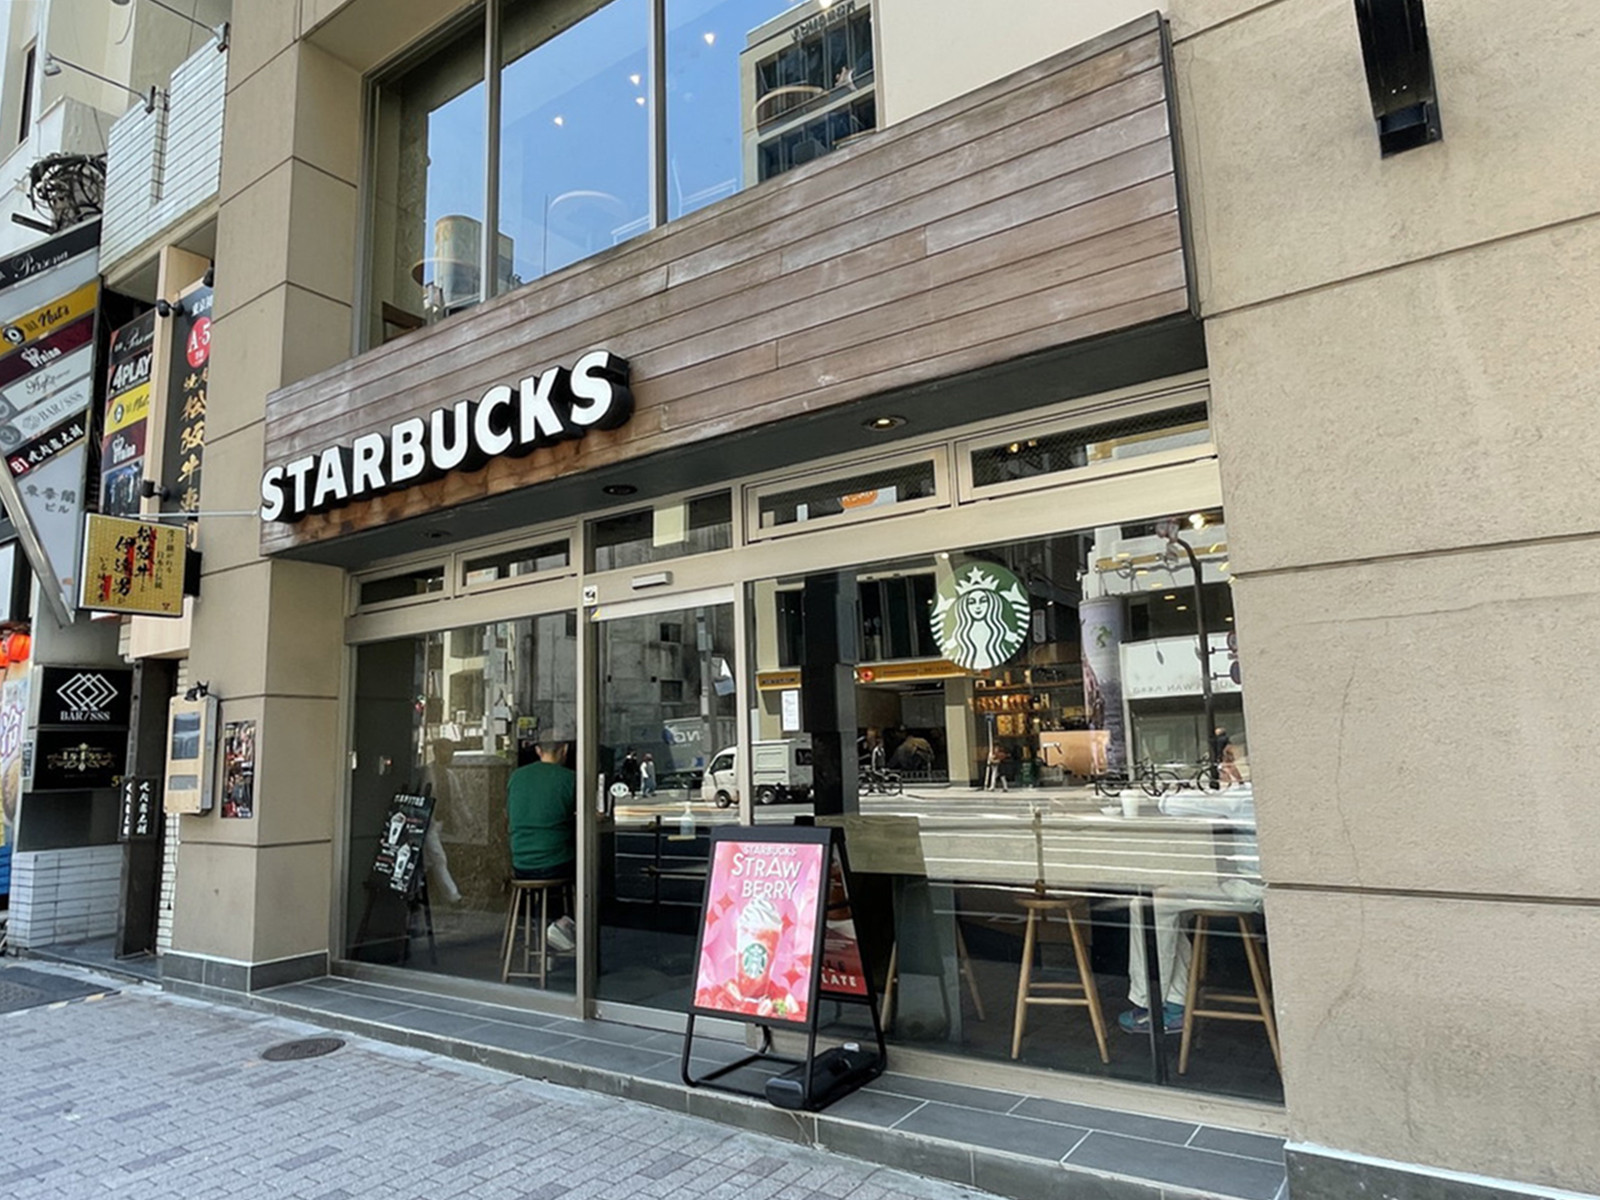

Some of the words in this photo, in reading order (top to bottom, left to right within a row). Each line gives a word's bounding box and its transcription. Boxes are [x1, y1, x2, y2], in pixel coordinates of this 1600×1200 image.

[260, 349, 619, 522] STARBUCKS
[10, 457, 30, 473] B1
[45, 502, 70, 514] ビル
[731, 853, 802, 879] STRAW
[742, 880, 797, 900] BERRY
